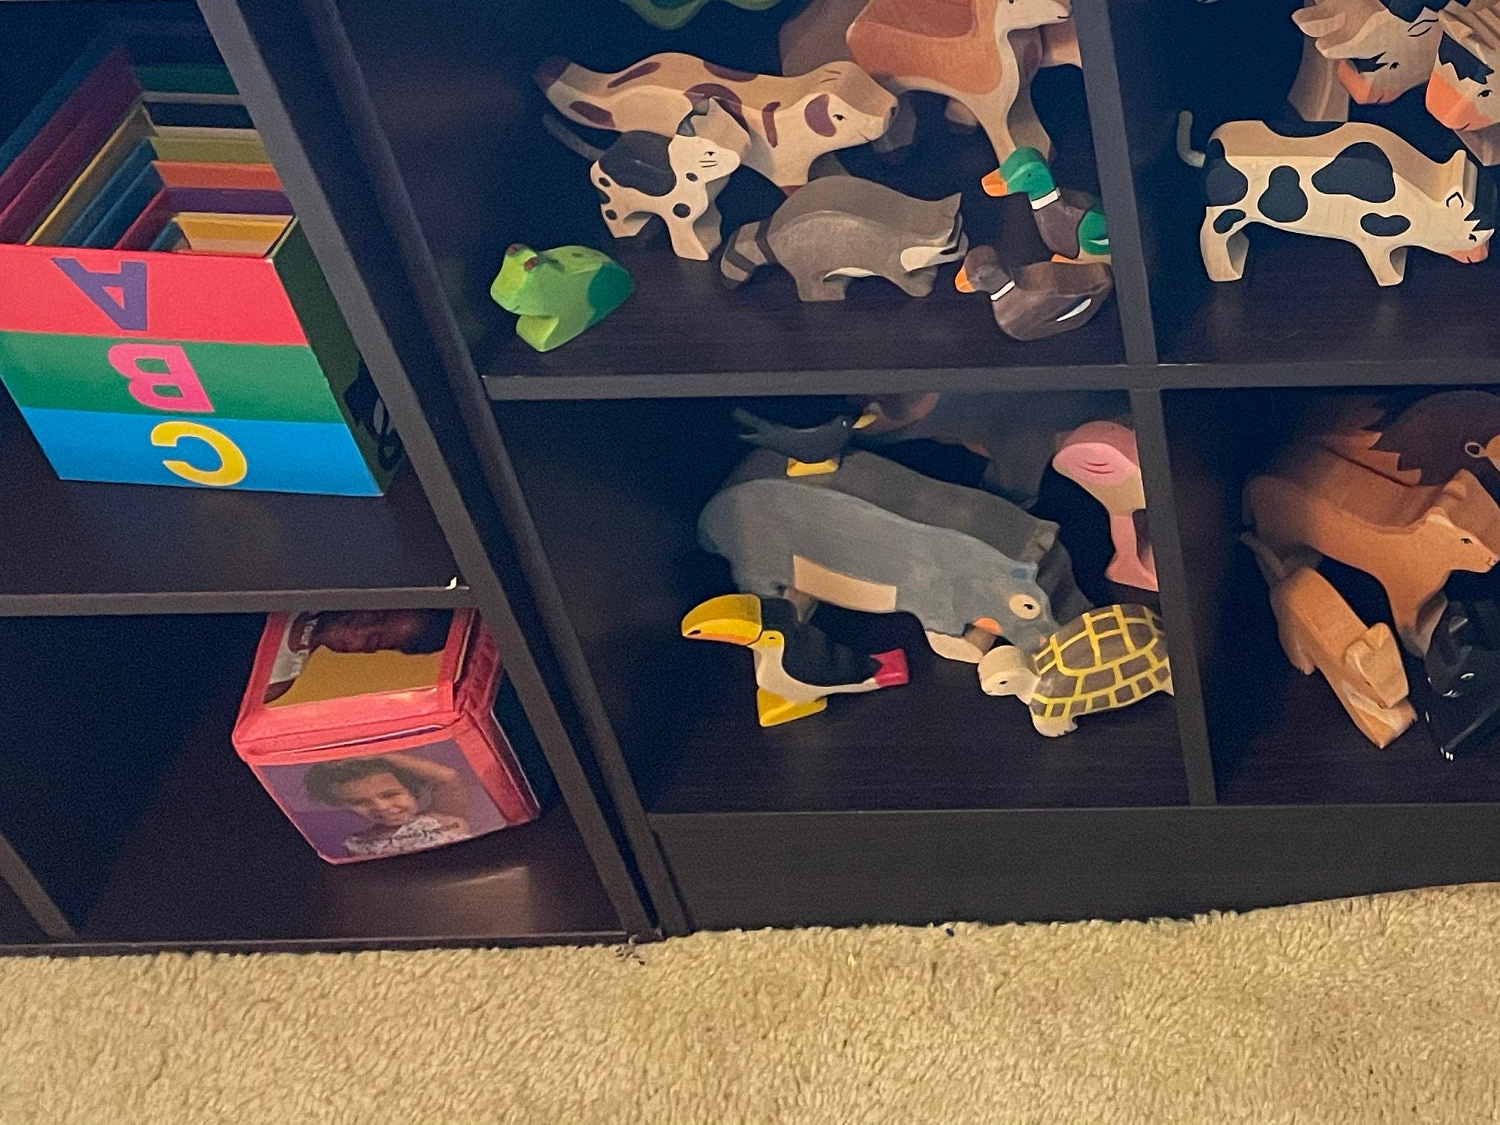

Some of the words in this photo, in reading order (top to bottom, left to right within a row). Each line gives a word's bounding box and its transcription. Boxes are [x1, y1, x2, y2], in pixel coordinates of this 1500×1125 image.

[51, 257, 147, 331] A
[107, 343, 214, 413] B
[150, 421, 247, 486] C
